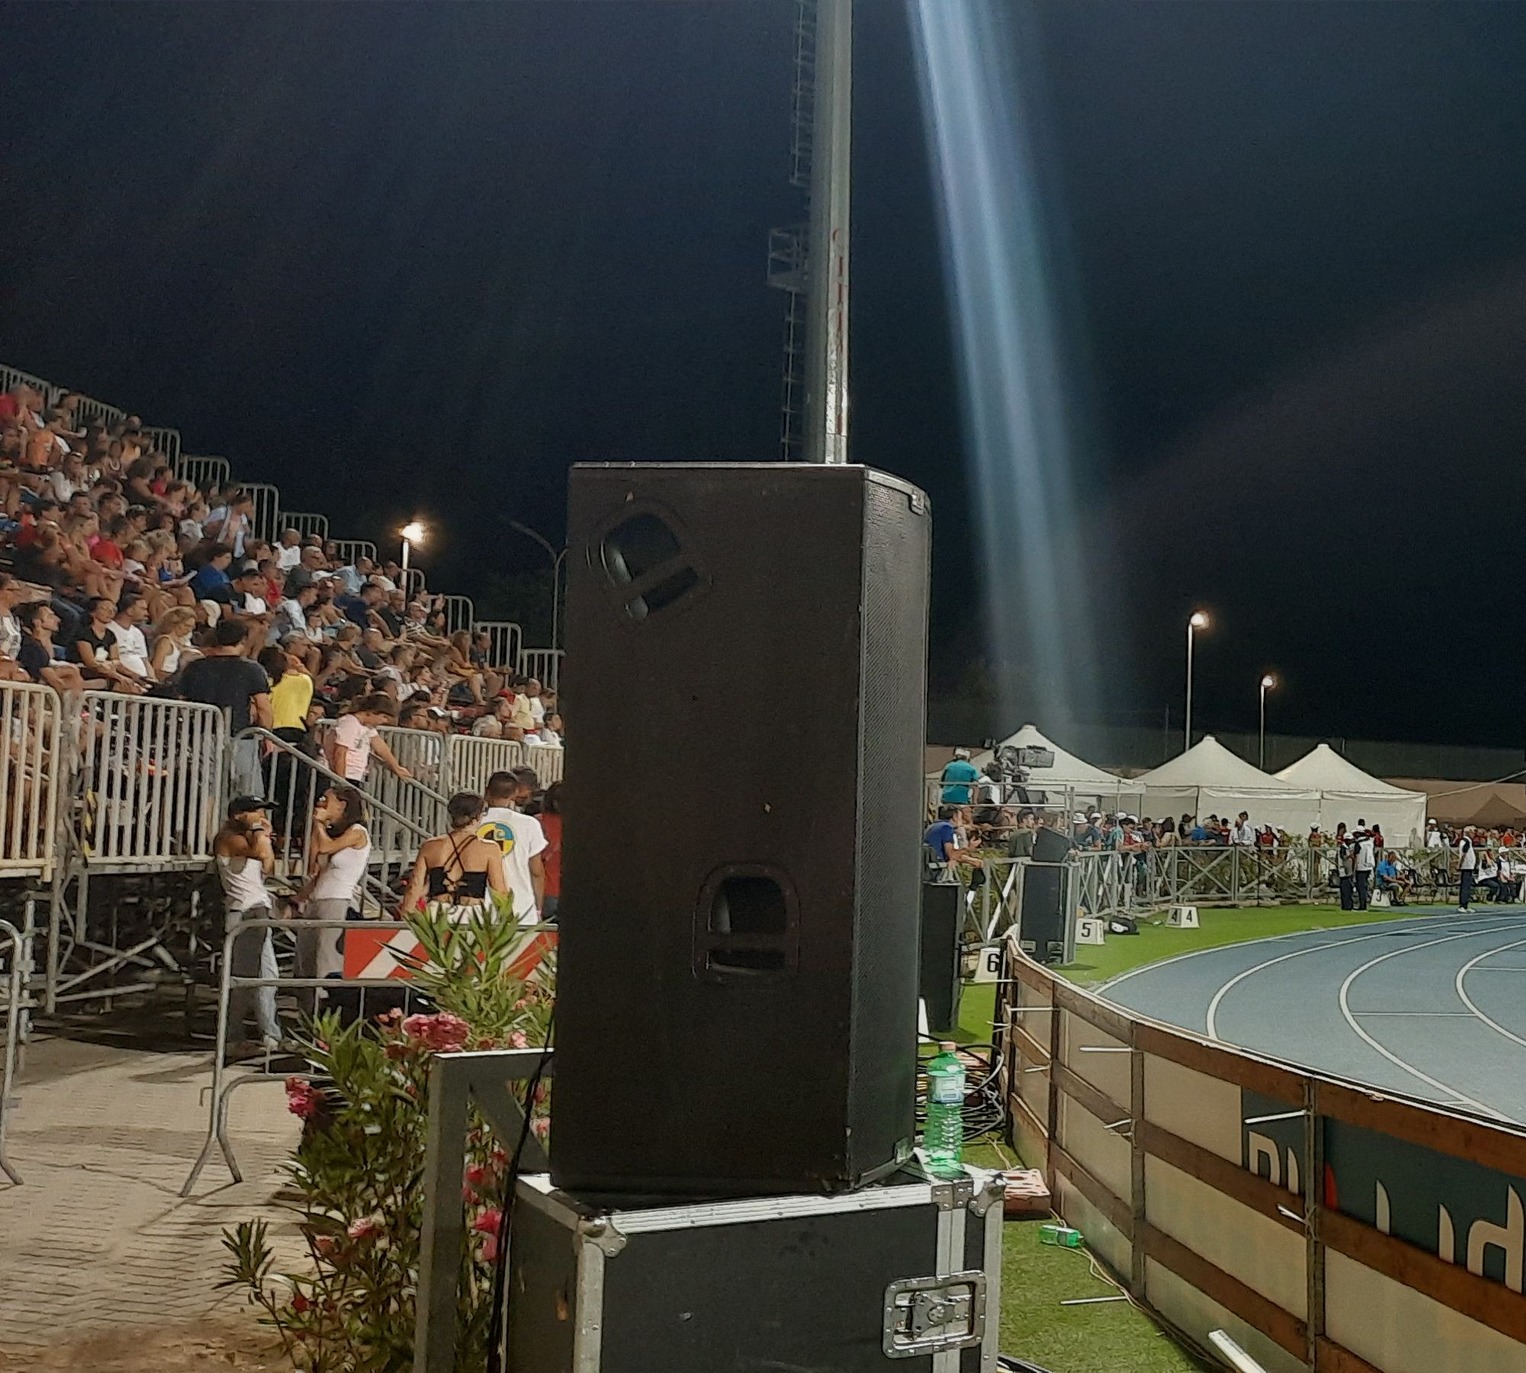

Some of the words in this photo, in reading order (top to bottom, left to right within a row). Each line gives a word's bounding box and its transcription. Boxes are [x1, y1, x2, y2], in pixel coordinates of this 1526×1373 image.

[1171, 908, 1178, 922] 4
[1185, 908, 1193, 923] 4
[1080, 922, 1091, 938] 5
[987, 953, 1000, 973] 6
